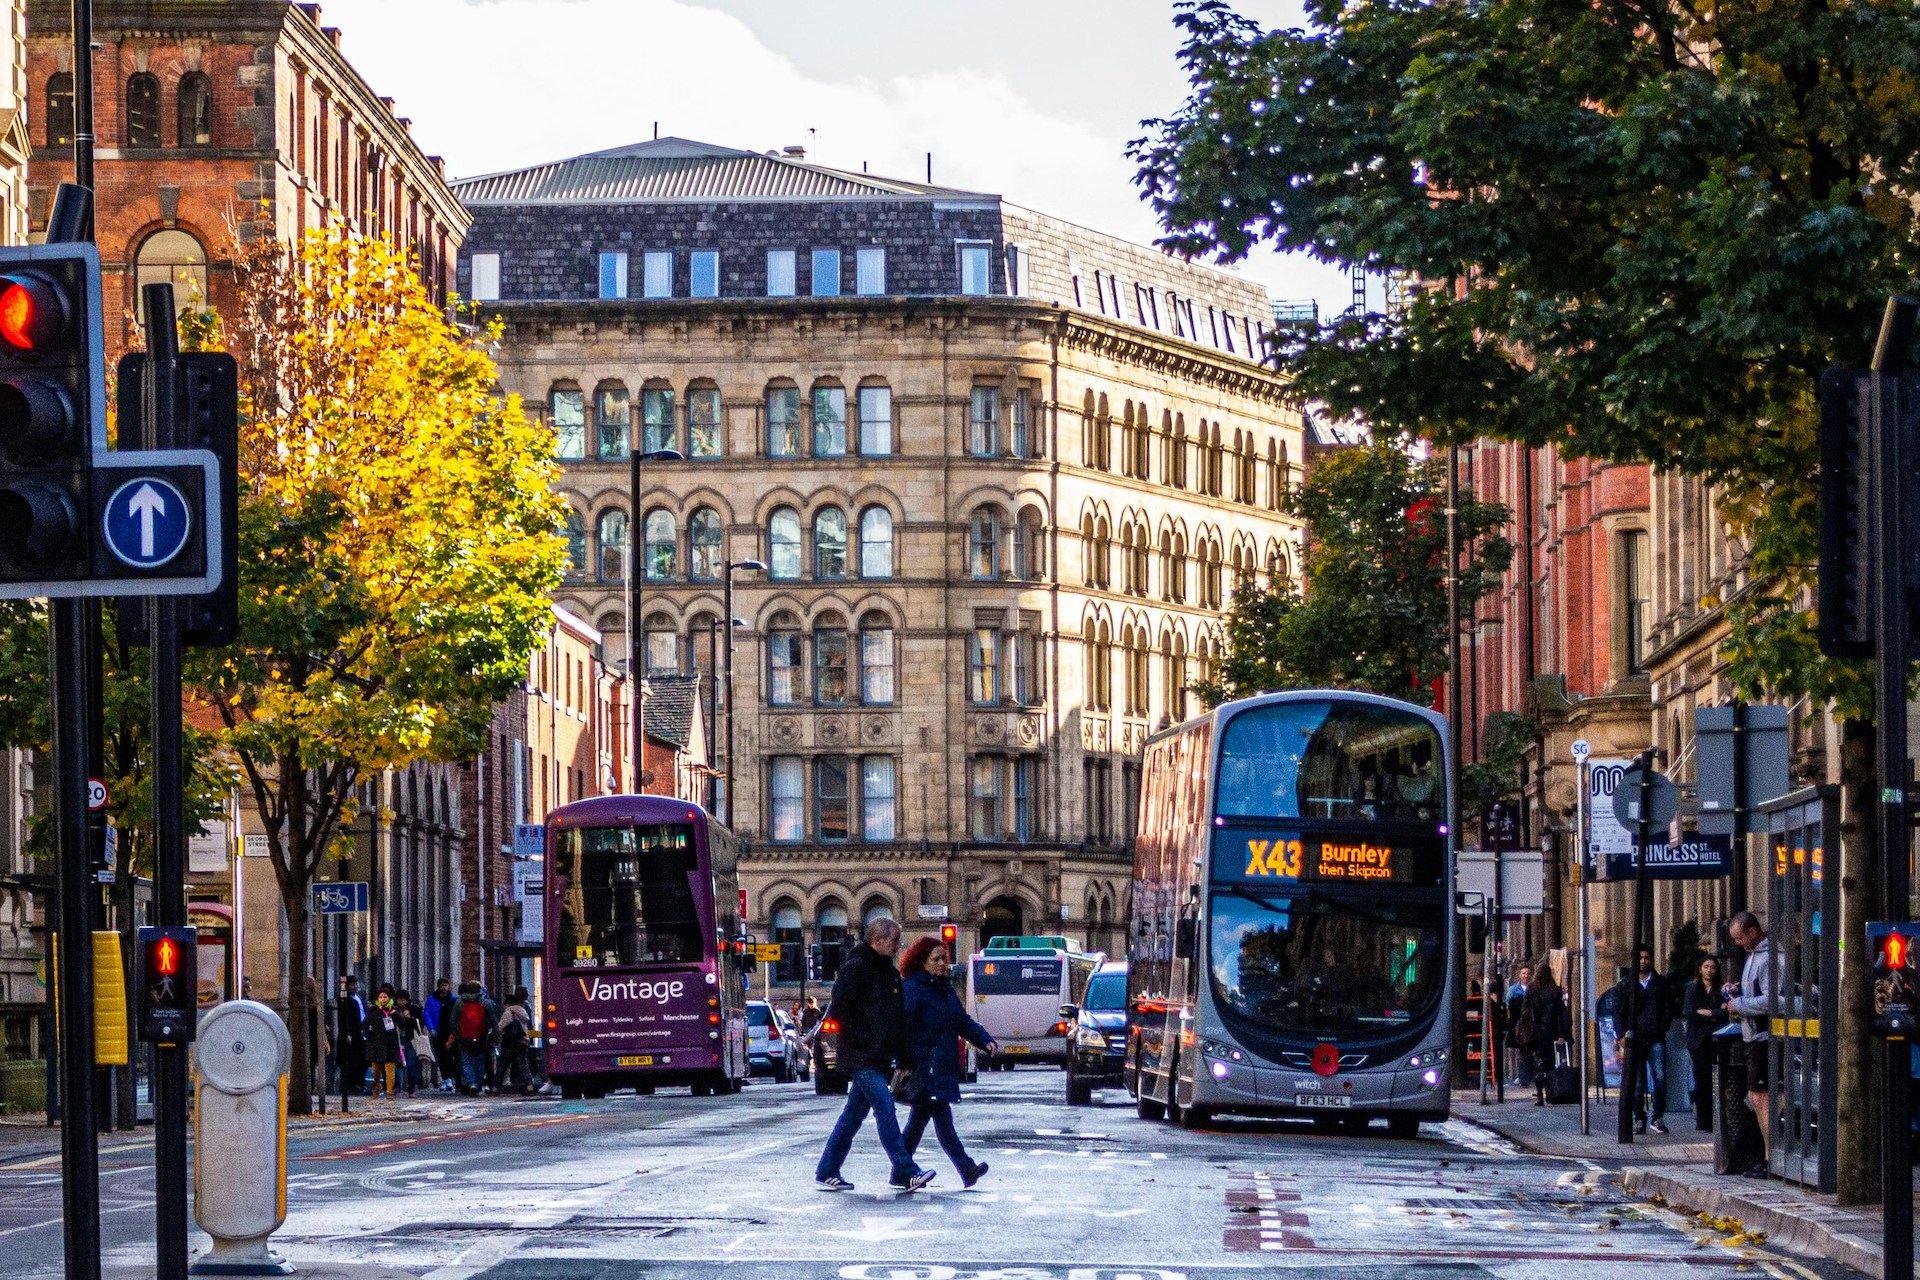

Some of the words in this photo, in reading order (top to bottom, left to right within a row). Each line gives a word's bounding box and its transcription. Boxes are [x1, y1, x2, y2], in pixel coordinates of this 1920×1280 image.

[1573, 744, 1588, 755] SG
[1245, 839, 1303, 877] X43
[1321, 843, 1391, 867] Burnley
[1631, 843, 1699, 862] PINCESS
[1699, 851, 1721, 861] HOTEL
[1318, 862, 1345, 876] then
[1347, 864, 1390, 879] Skipton
[573, 958, 598, 968] 39260
[579, 977, 684, 1004] Vantage
[565, 1018, 584, 1027] Leigh
[663, 1013, 700, 1021] Manchester
[596, 1030, 672, 1039] www.firstgroup.com/vantage
[1205, 1026, 1224, 1036] 2769
[1299, 1095, 1326, 1106] BF63
[1327, 1096, 1347, 1107] HCL
